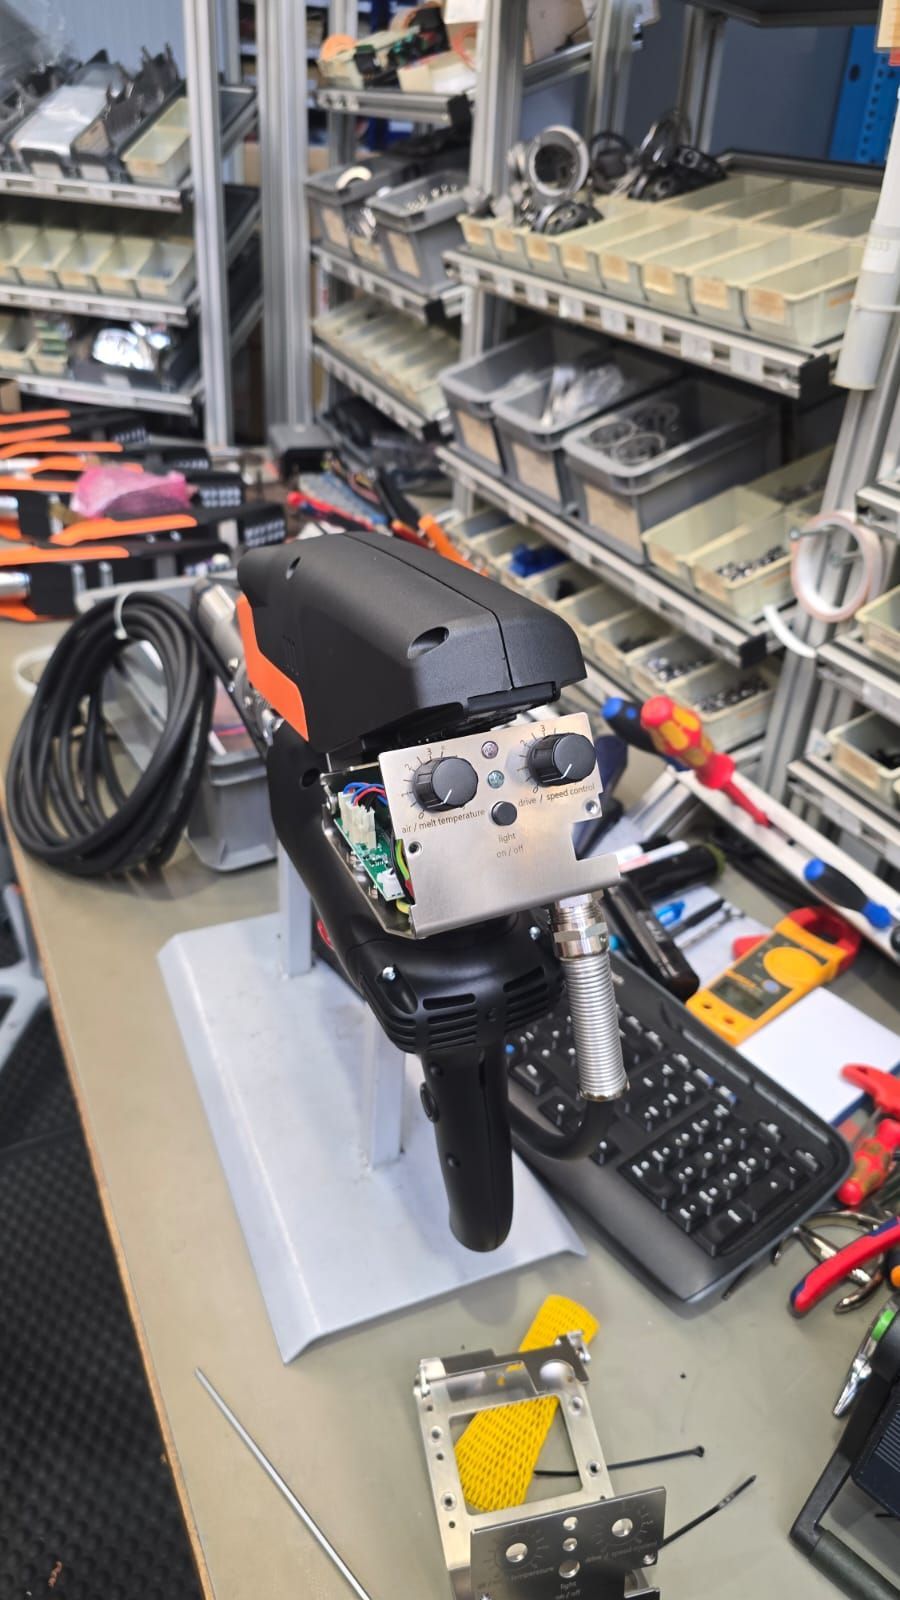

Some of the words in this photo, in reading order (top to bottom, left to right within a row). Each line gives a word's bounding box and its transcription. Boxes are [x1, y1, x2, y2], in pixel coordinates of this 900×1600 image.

[519, 797, 537, 807] drive
[546, 790, 569, 801] speed
[570, 784, 595, 795] control
[401, 825, 411, 833] air
[420, 819, 437, 829] melt
[437, 809, 485, 825] temperature
[498, 833, 516, 843] light
[496, 850, 507, 858] on
[513, 846, 524, 854] off
